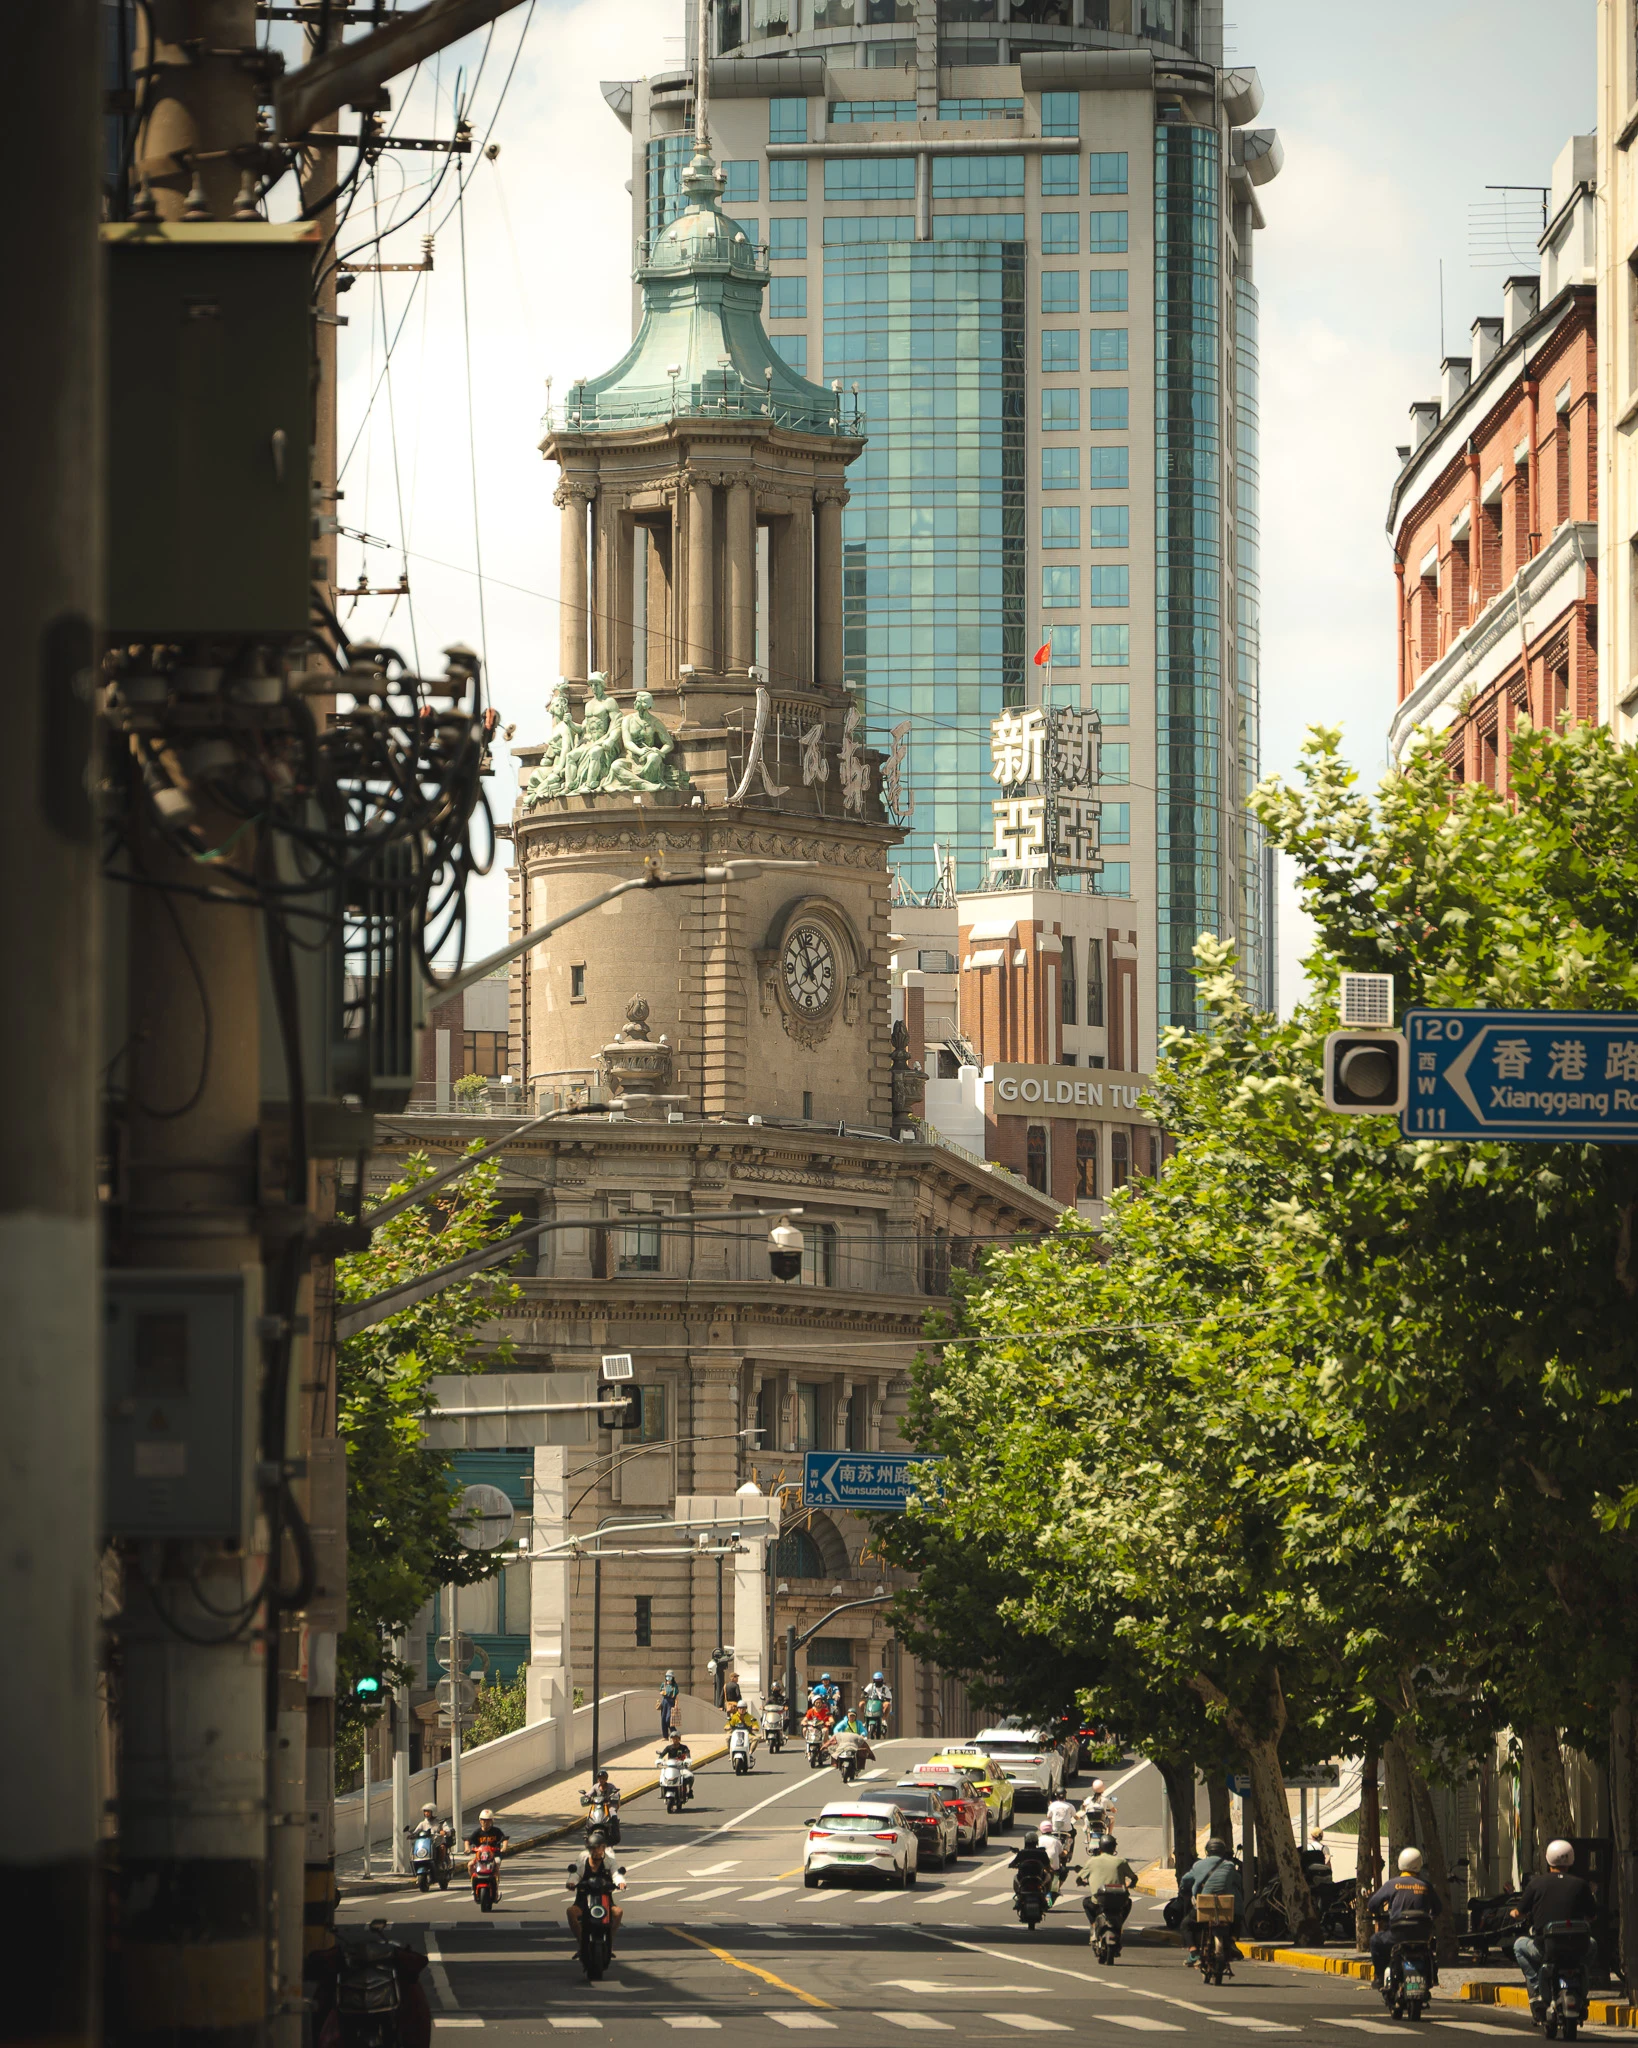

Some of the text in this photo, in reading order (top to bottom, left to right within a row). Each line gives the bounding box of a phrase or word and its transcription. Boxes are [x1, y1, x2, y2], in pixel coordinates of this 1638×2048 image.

[787, 962, 794, 974] 9
[823, 967, 831, 978] 3
[805, 995, 812, 1007] 6
[1415, 1019, 1464, 1041] 120
[1418, 1052, 1437, 1071] 西
[1492, 1038, 1638, 1081] 香港路
[998, 1077, 1103, 1107] GOLDEN
[1418, 1077, 1436, 1095] W
[1490, 1085, 1609, 1116] Xianggang
[1416, 1108, 1446, 1129] 111
[839, 1464, 911, 1484] 南苏州路
[809, 1480, 819, 1489] W
[840, 1484, 896, 1497] Nansuzhou
[806, 1493, 833, 1504] 245
